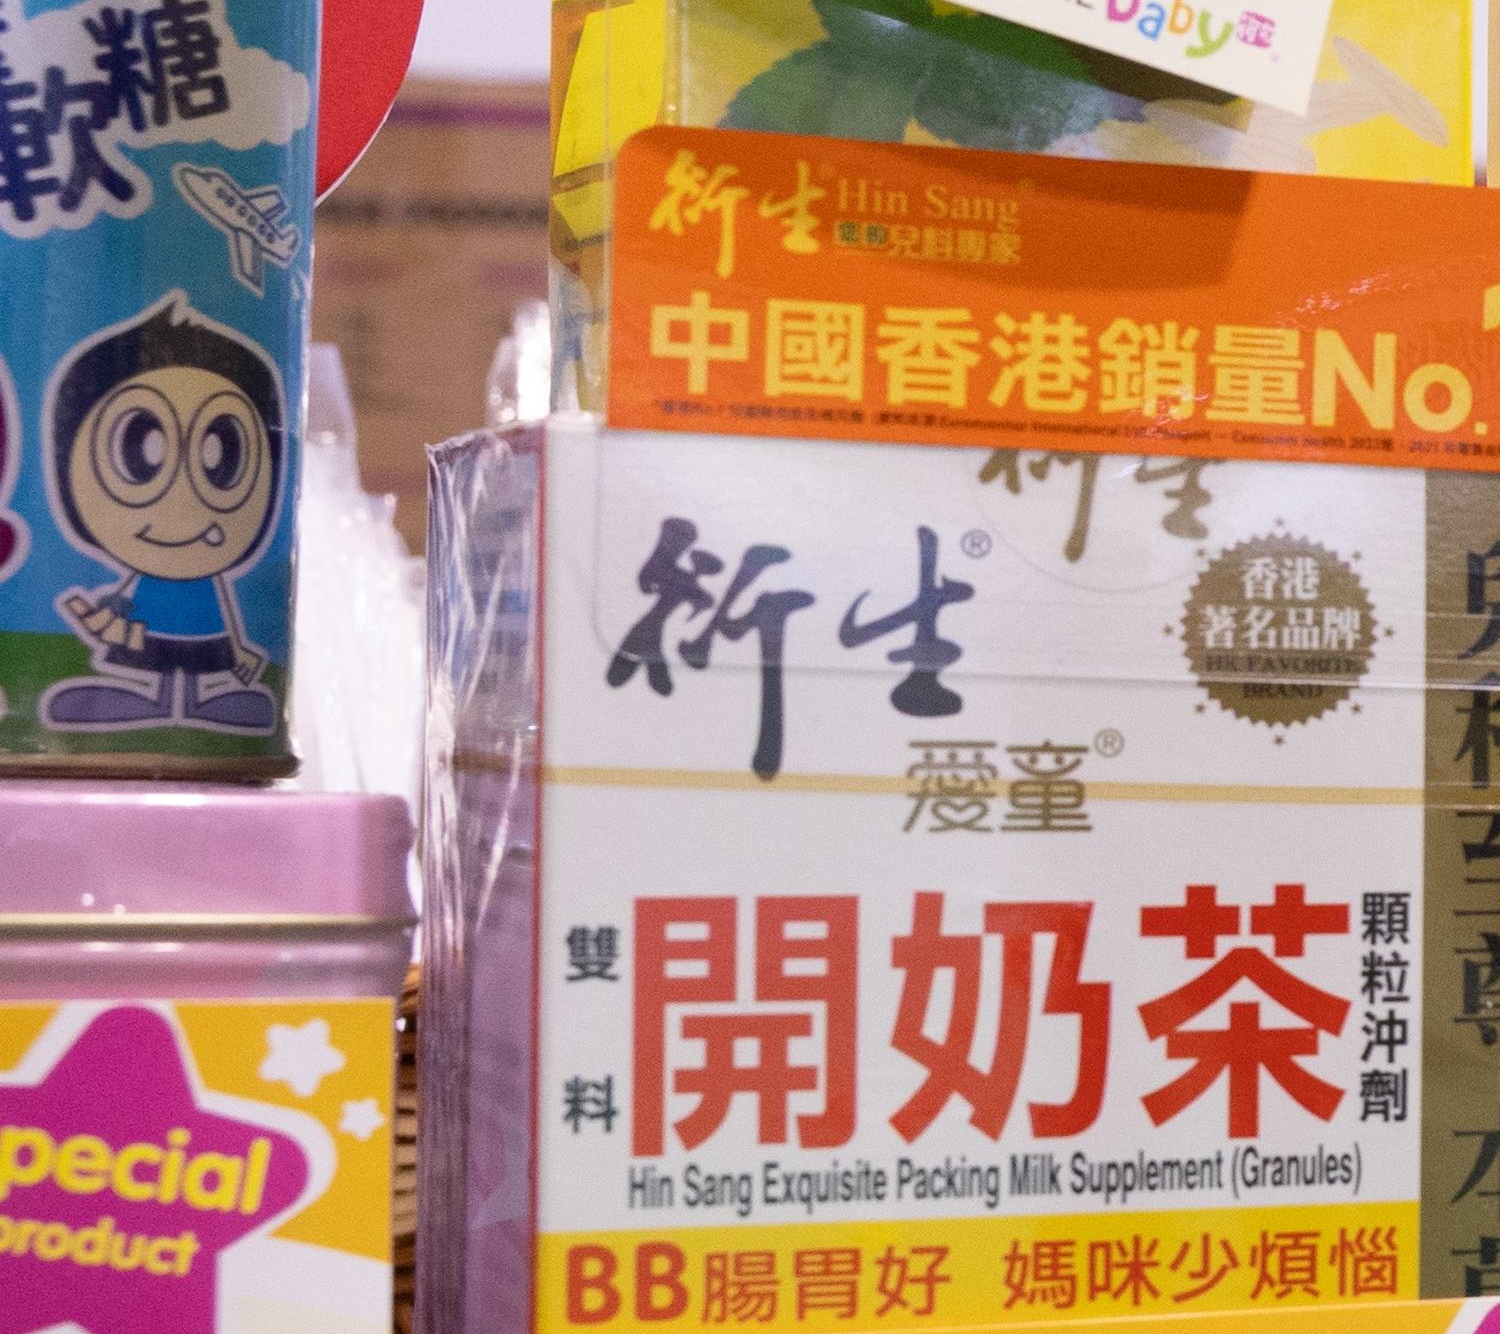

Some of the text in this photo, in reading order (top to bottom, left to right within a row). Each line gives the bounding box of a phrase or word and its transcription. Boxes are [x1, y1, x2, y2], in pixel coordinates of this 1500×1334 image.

[834, 180, 1020, 229] Hin Sang
[1238, 557, 1320, 600] 香港
[606, 514, 975, 781] 衍生
[1203, 603, 1362, 651] 著名品牌
[902, 738, 1093, 834] 愛童
[629, 882, 1354, 1159] 開奶茶
[627, 1139, 1365, 1220] Hin Sang Exquisite Packing Milk Supplement (Granules)
[563, 1225, 1401, 1328] BB腸胃好 媽咪少煩惱
